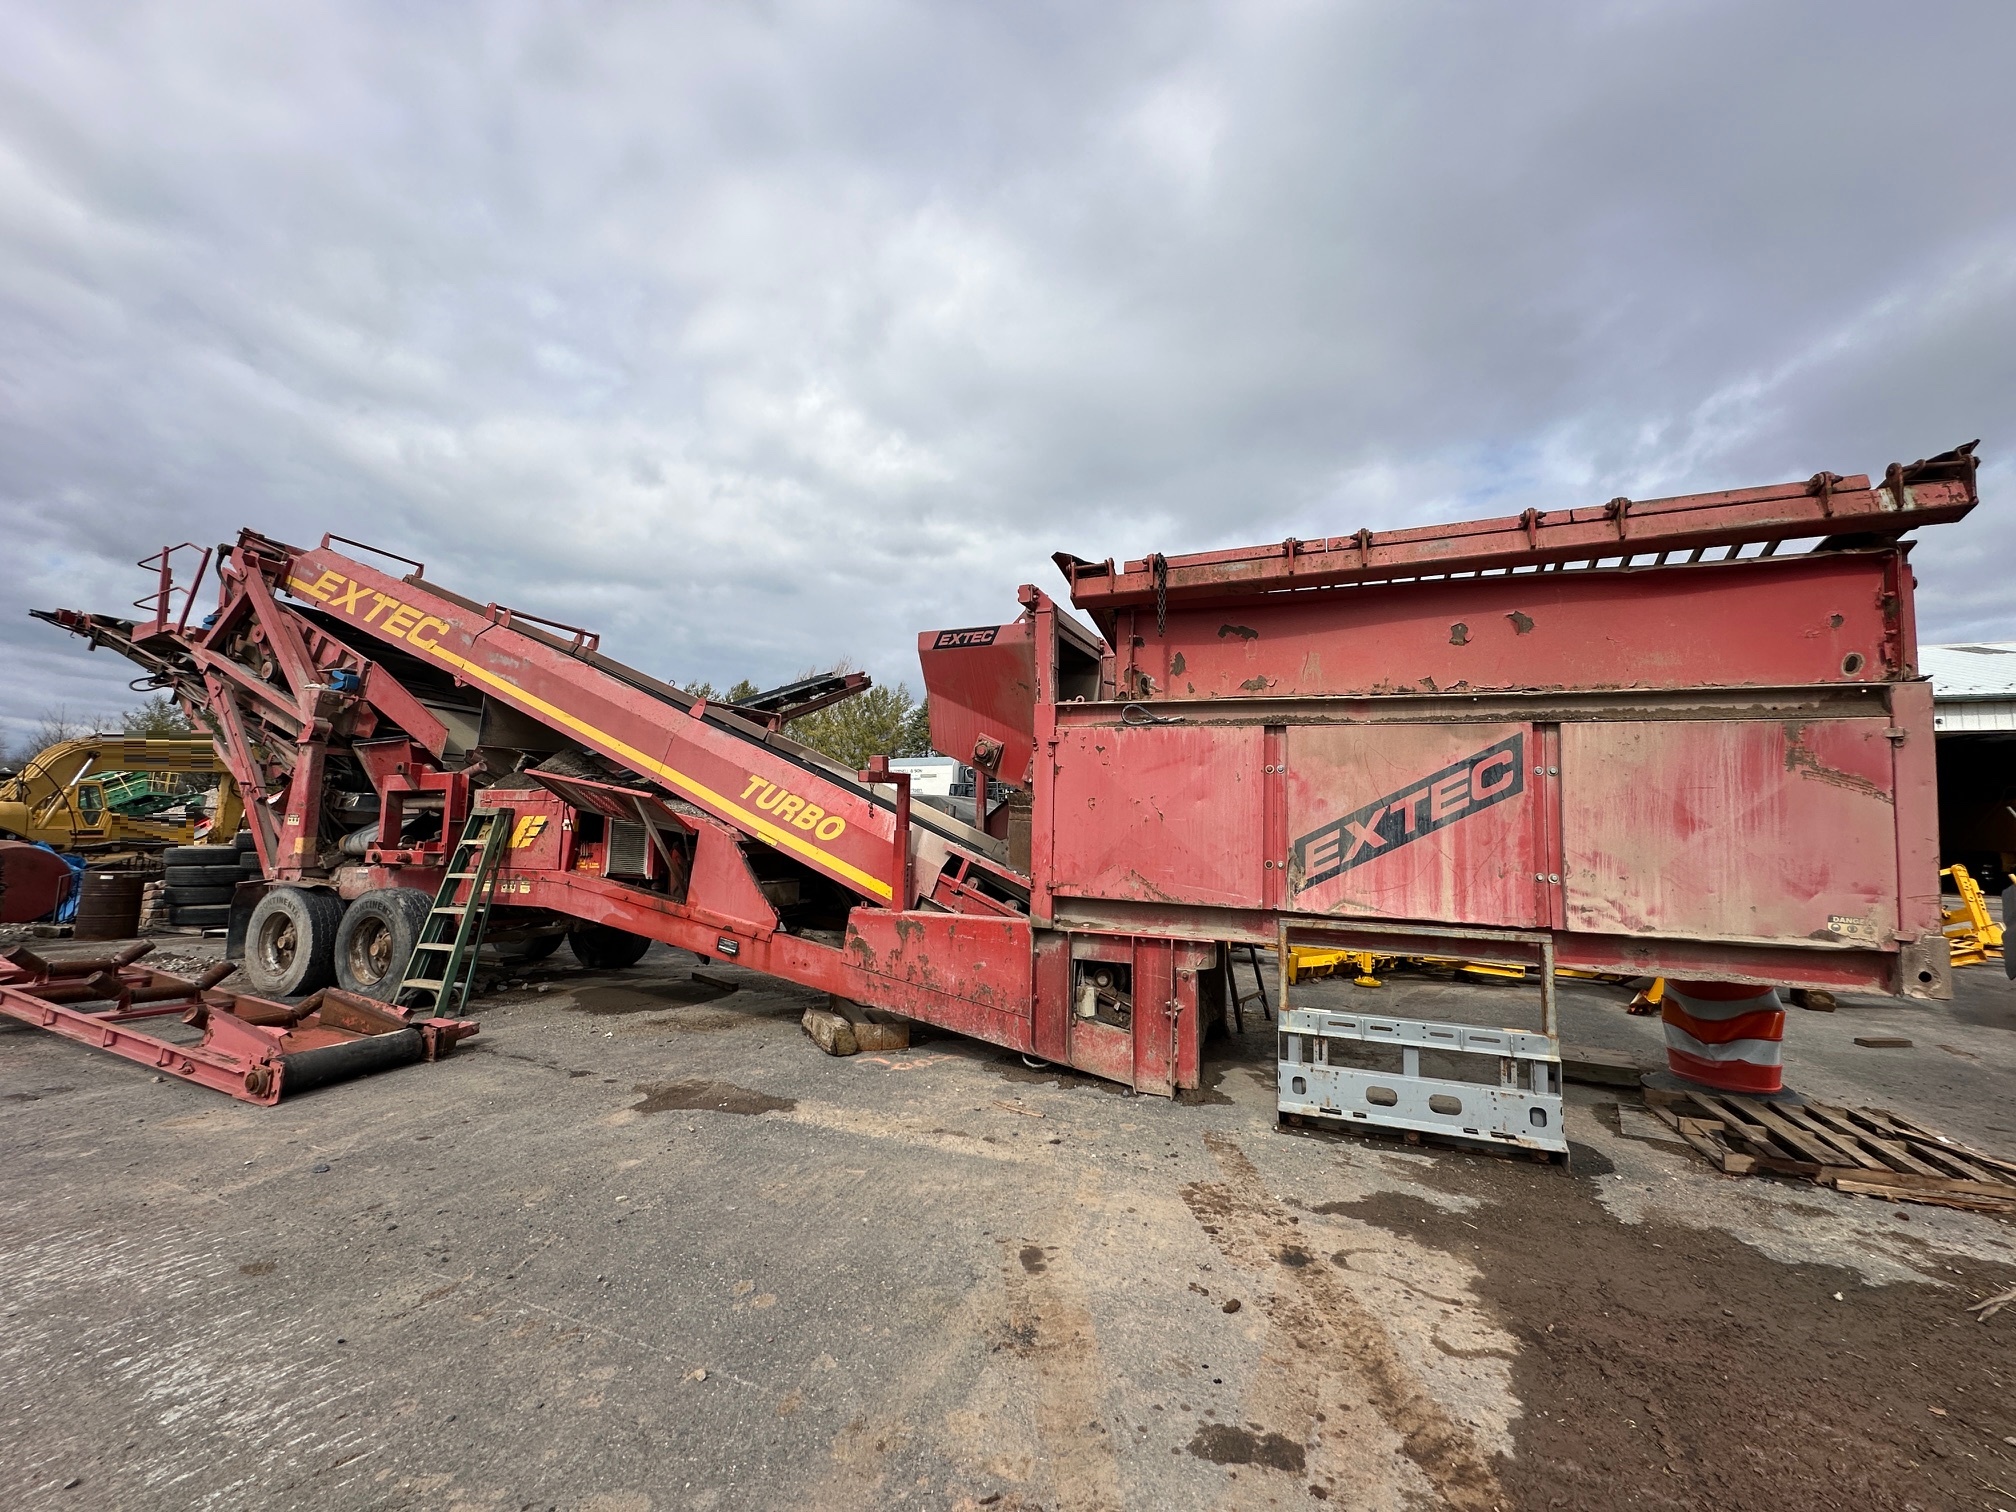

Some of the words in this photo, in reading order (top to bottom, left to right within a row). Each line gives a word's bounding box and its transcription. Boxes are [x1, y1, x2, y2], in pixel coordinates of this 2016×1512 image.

[309, 569, 450, 649] EXTEC
[938, 629, 995, 646] EXTEC
[740, 774, 846, 841] TURBO
[1304, 749, 1514, 880] EXTEC
[350, 900, 396, 920] CONTINENT
[1832, 916, 1868, 925] DANGE
